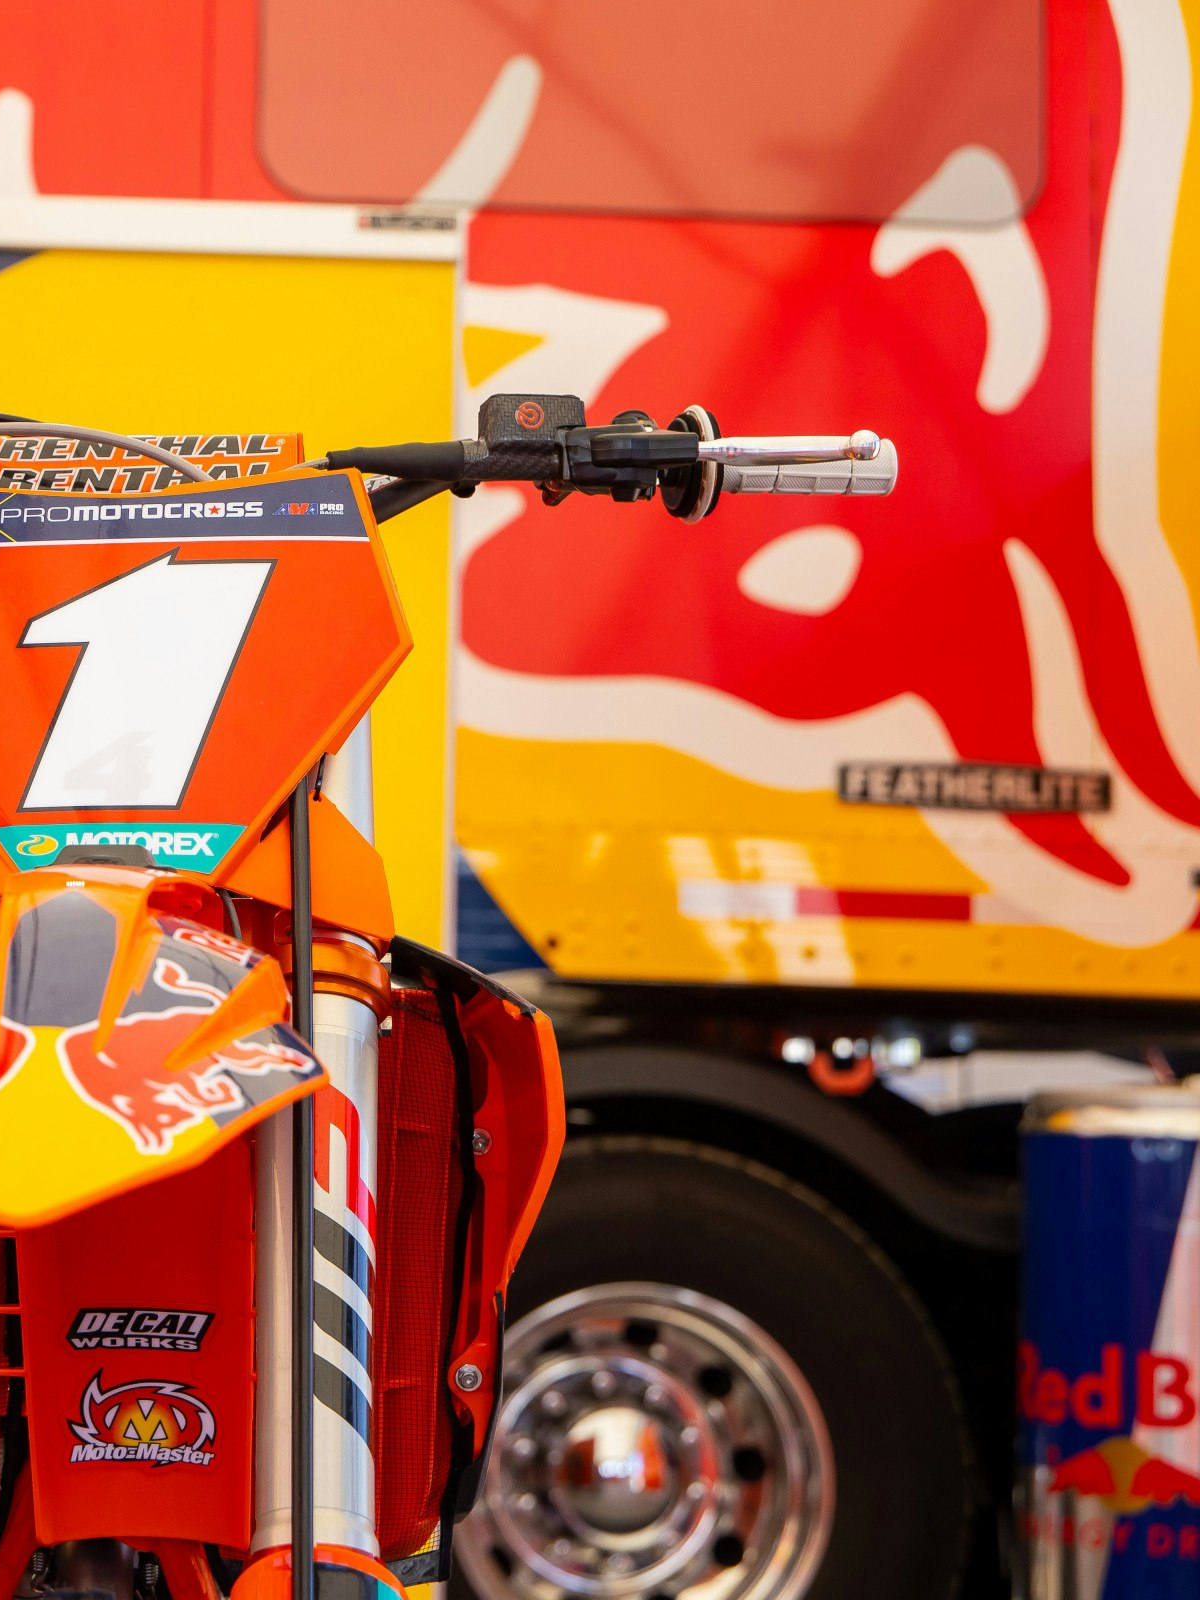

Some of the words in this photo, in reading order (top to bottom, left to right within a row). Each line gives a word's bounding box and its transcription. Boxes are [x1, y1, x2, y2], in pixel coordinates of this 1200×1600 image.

[271, 502, 319, 516] AMA
[319, 503, 344, 511] PRO
[16, 546, 278, 813] 1
[844, 763, 1102, 809] FEATHERLITE
[71, 1337, 198, 1350] WORKS
